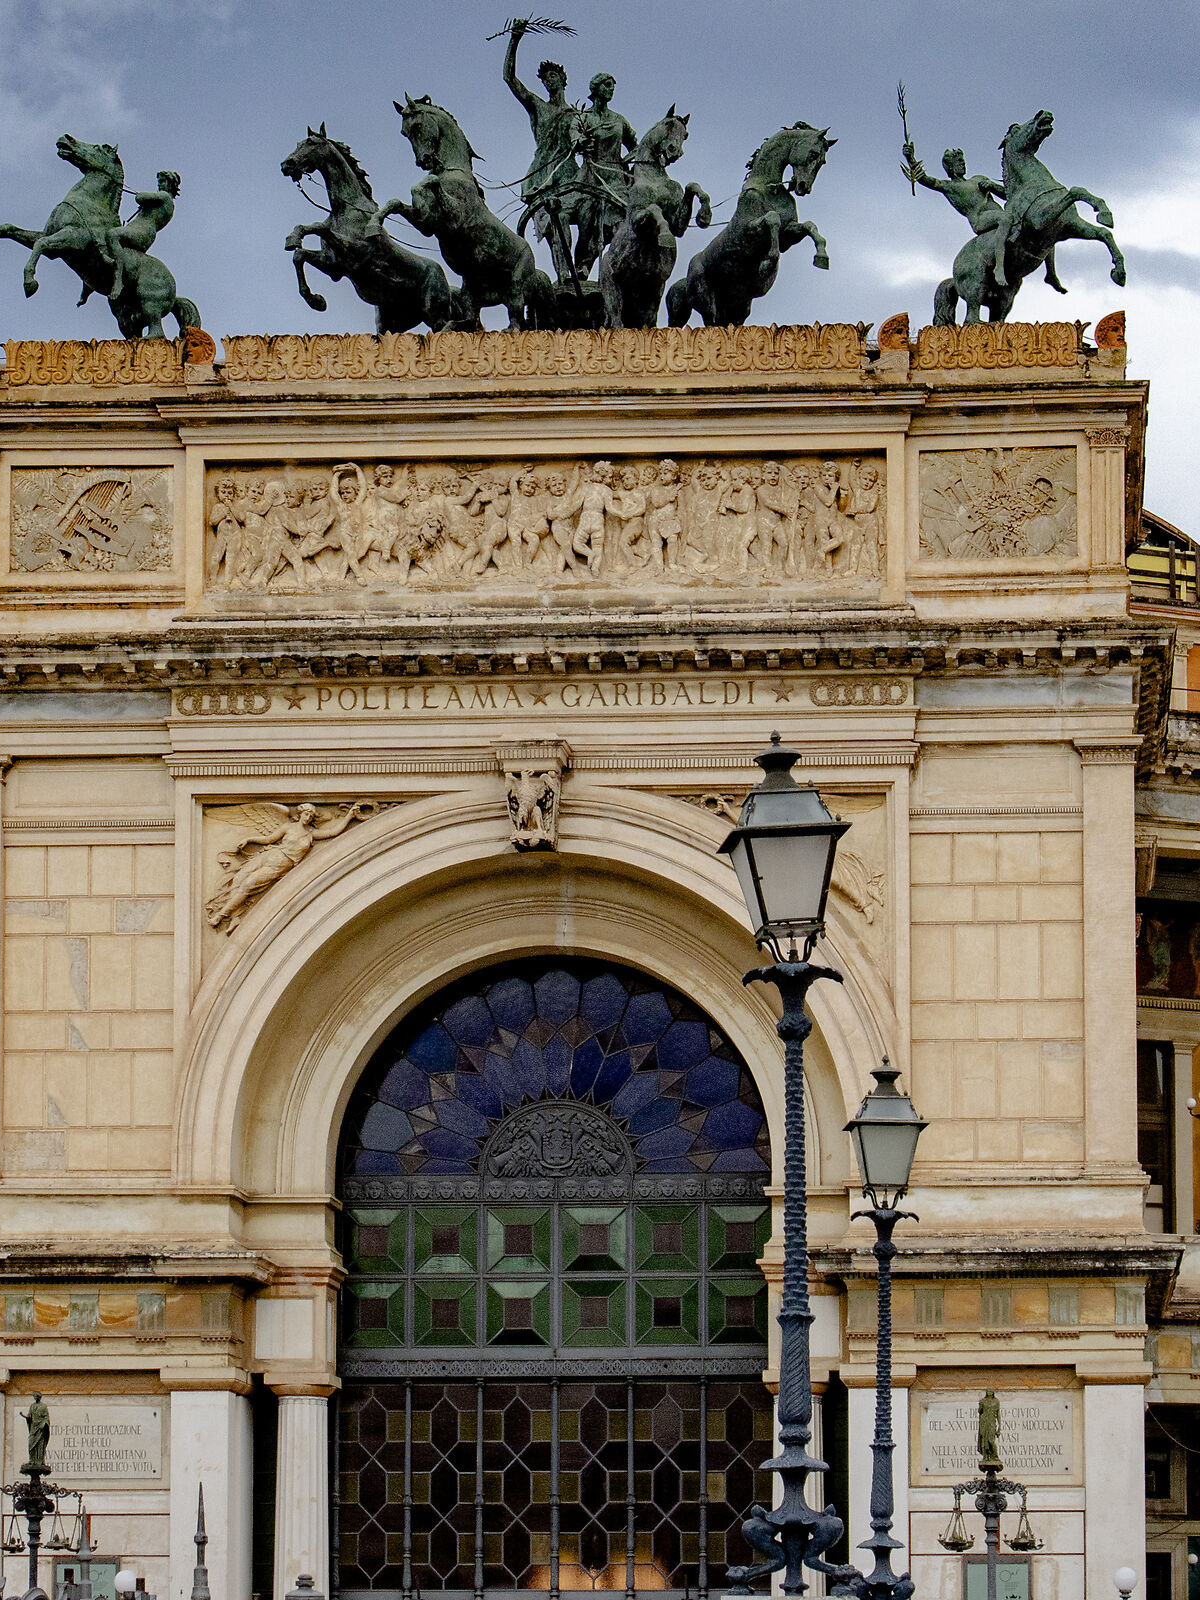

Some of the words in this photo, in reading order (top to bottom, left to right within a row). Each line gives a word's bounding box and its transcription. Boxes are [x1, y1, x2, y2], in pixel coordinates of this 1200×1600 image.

[316, 685, 524, 711] POLITEAMA
[560, 680, 755, 708] GARIBALDI
[91, 1449, 147, 1460] PALERMITANO
